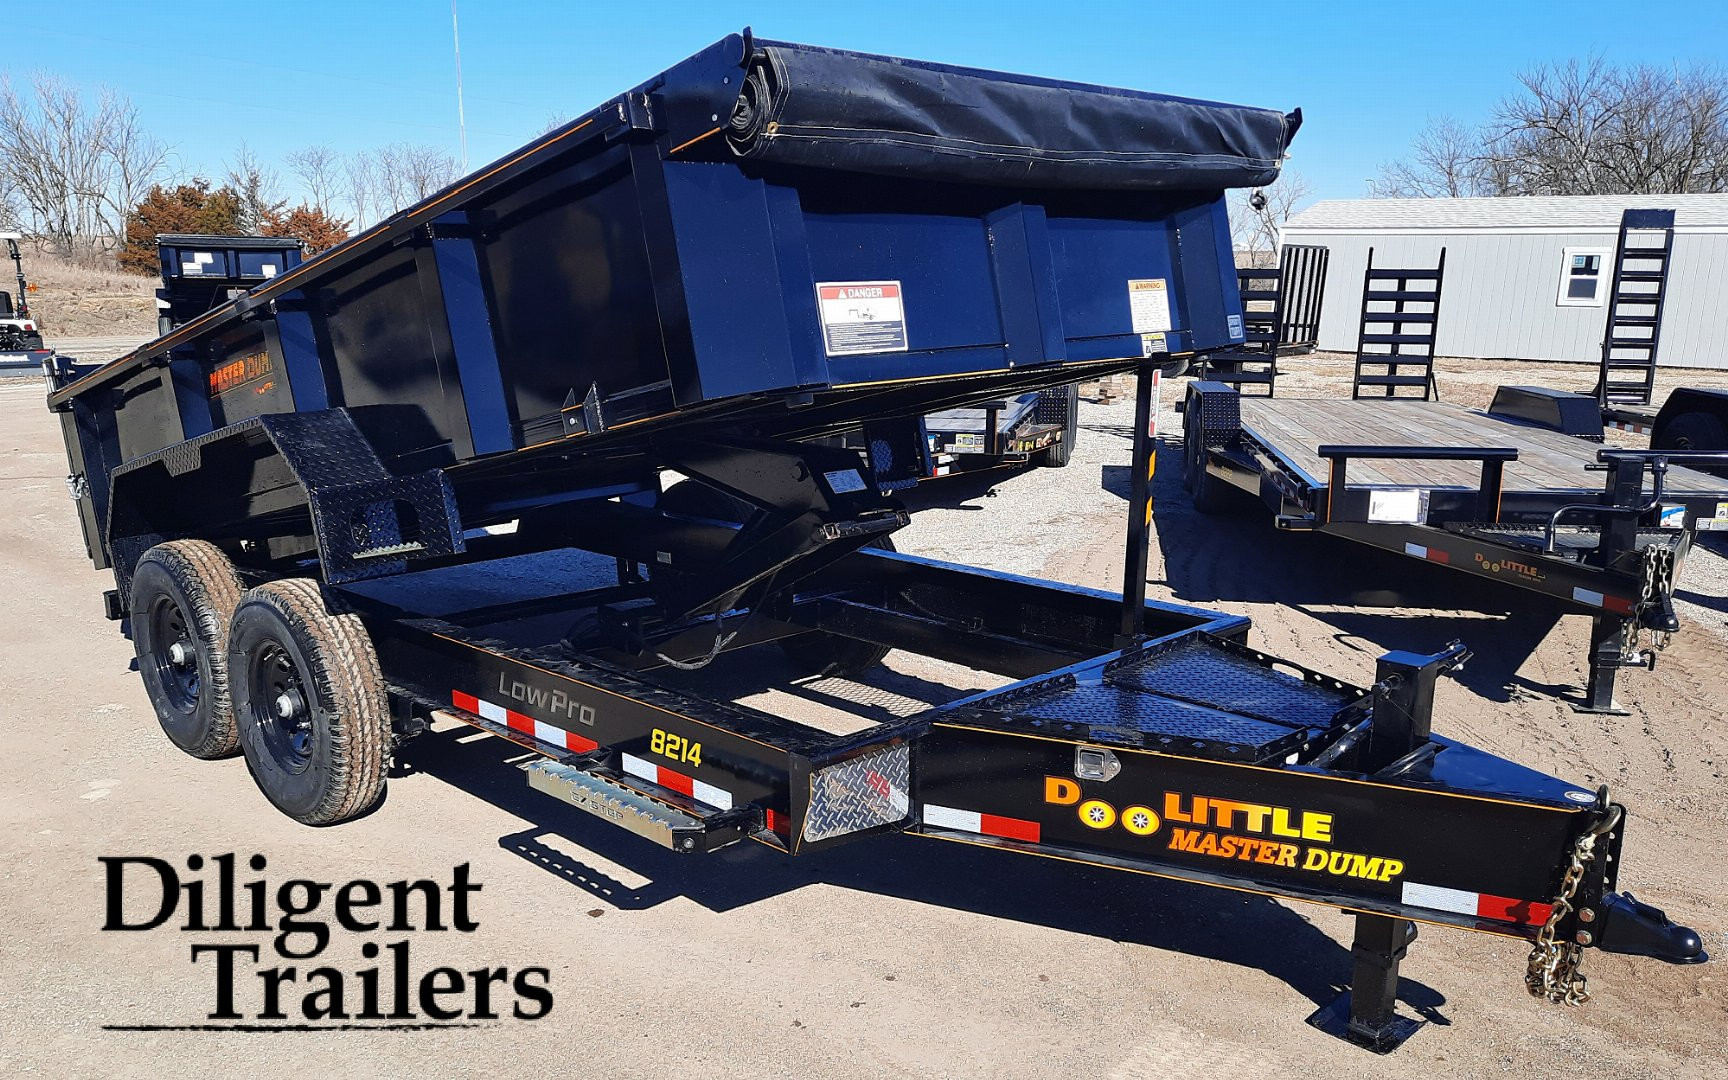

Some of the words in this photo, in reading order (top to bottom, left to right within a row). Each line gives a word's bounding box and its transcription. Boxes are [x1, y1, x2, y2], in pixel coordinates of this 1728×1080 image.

[848, 287, 883, 298] DANGER
[1139, 282, 1161, 290] WARNING
[209, 359, 246, 395] MASTER
[650, 728, 702, 768] 8214
[1167, 828, 1300, 868] MASTER
[1302, 847, 1405, 883] DUMP
